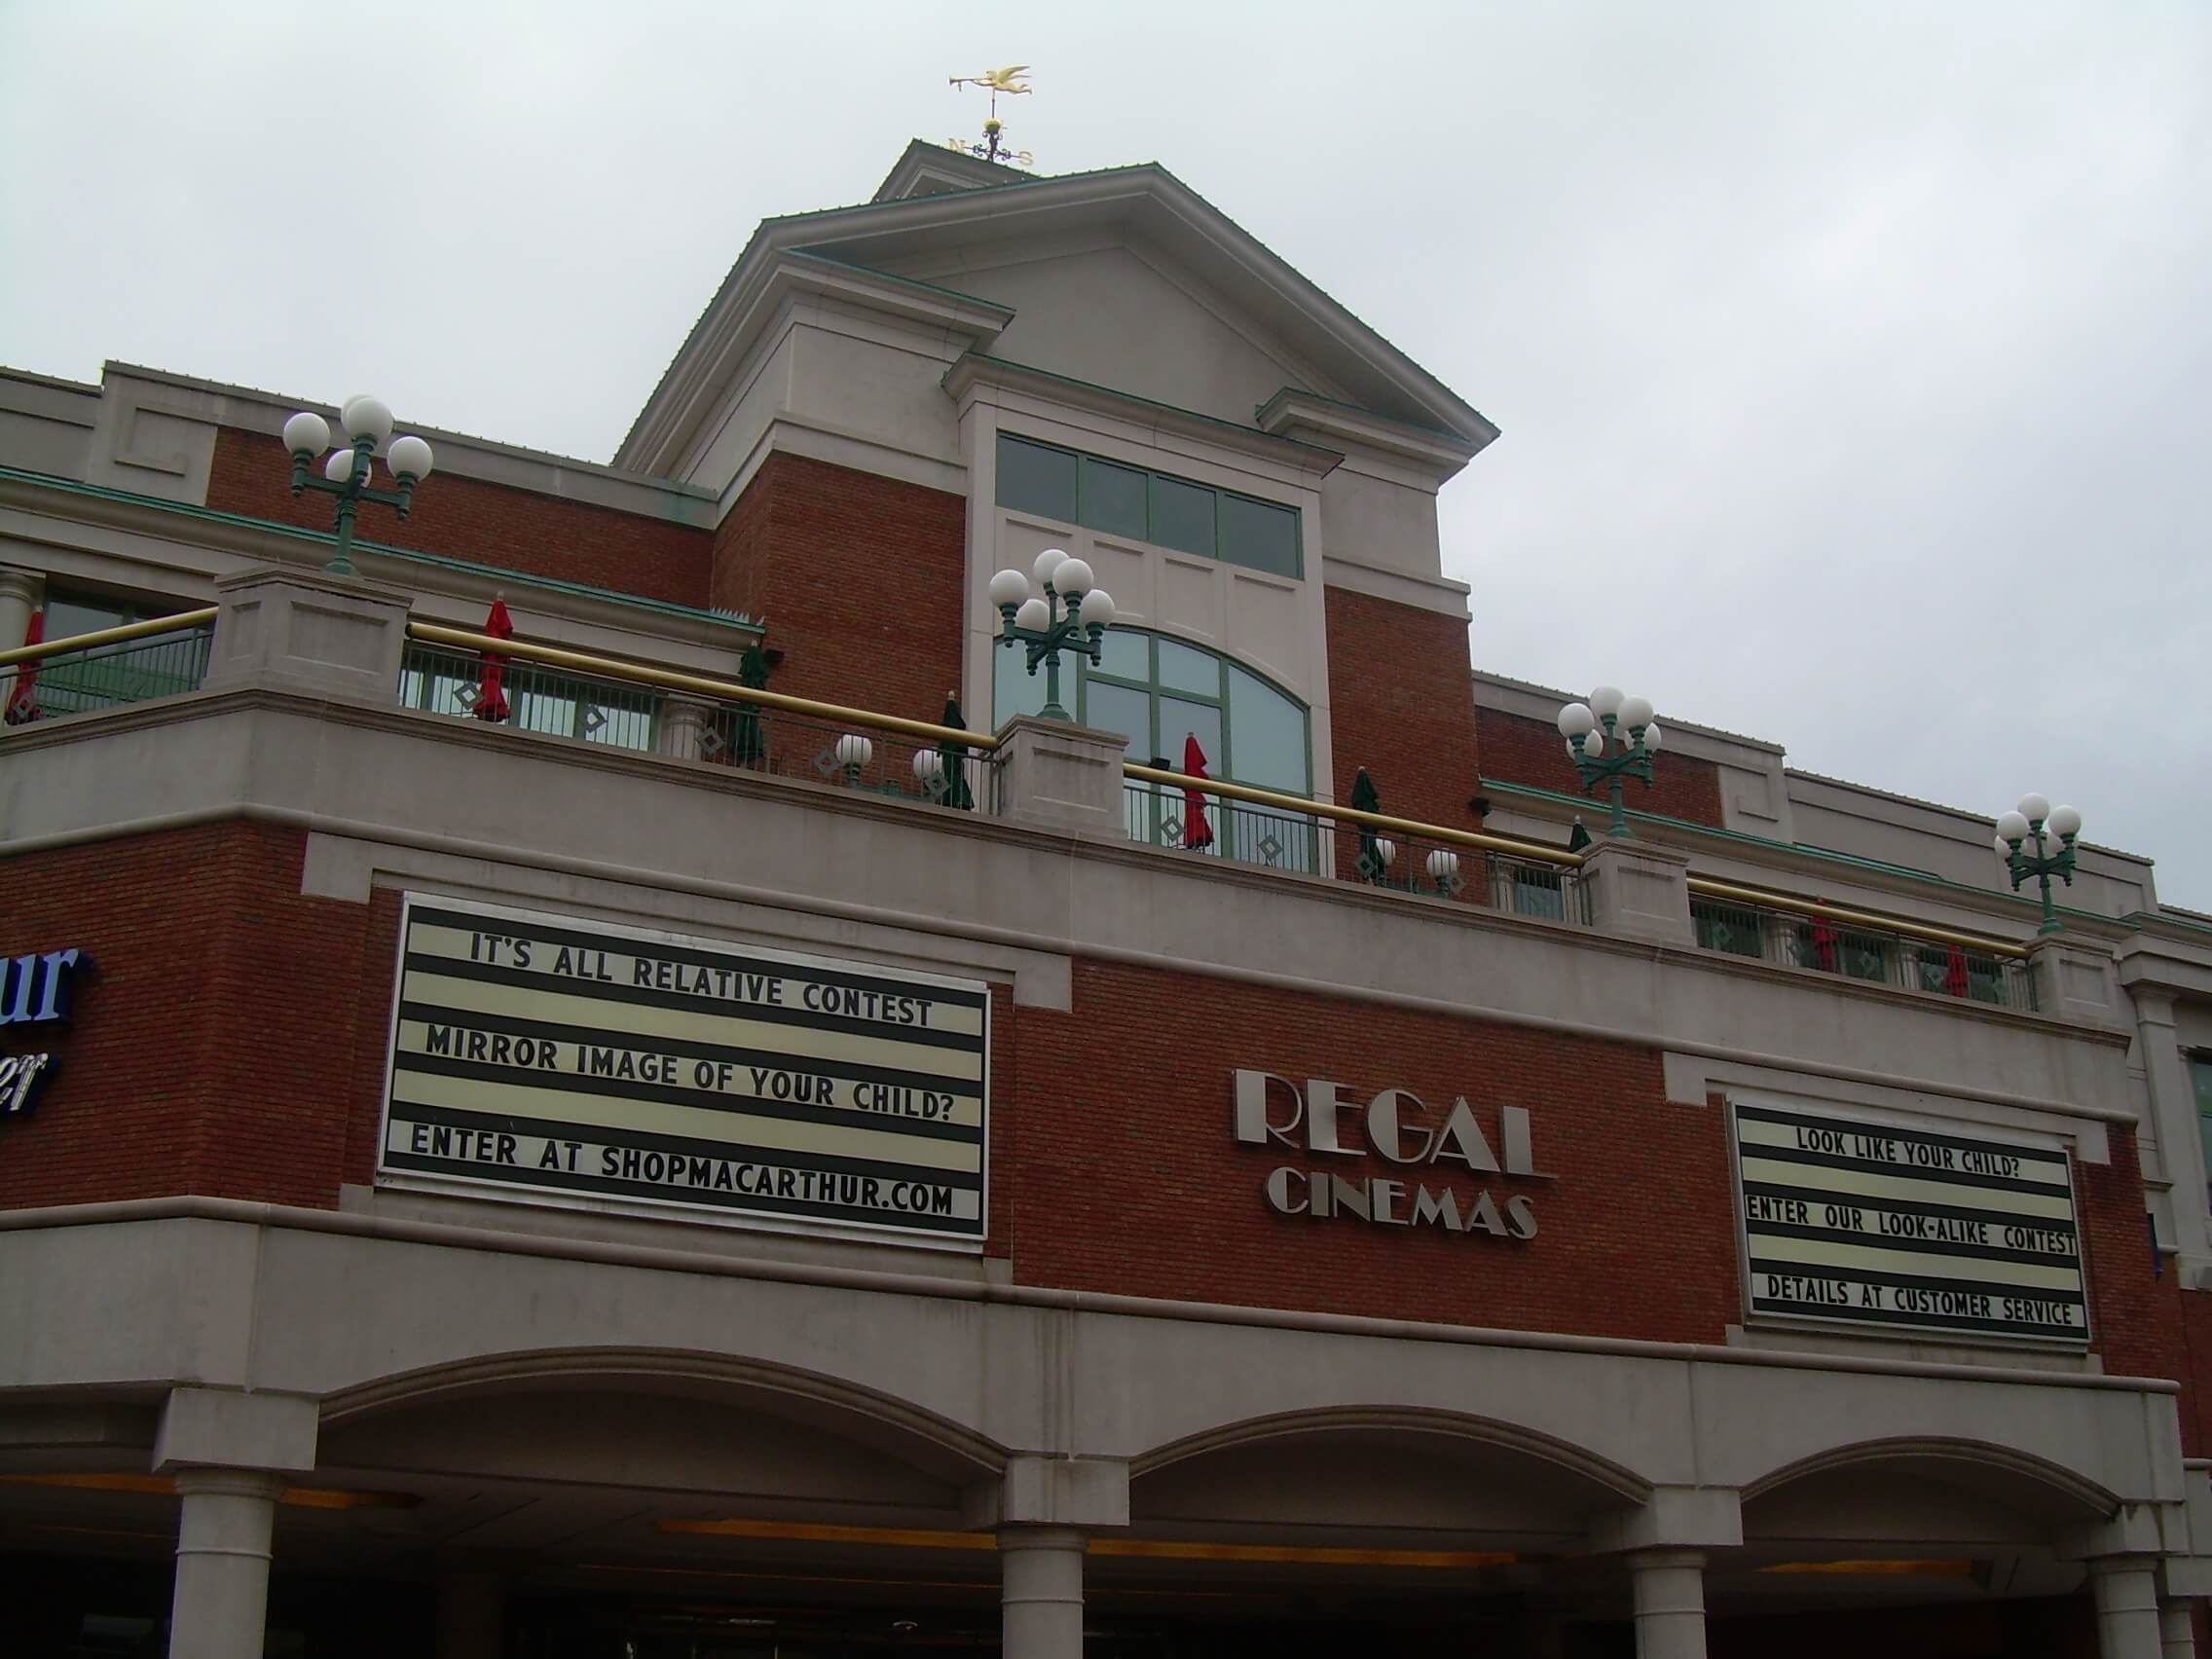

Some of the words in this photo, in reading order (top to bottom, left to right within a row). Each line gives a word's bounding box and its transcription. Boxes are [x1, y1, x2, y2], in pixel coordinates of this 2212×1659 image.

[470, 933, 532, 968] IT'S
[553, 946, 612, 981] ALL
[633, 958, 783, 1005] RELATIVE
[803, 984, 933, 1027] CONTEST
[426, 1023, 557, 1069] MIRROR
[577, 1045, 678, 1085] IMAGE
[694, 1060, 734, 1090] OF
[750, 1067, 834, 1106] YOUR
[854, 1084, 955, 1123] CHILD?
[1232, 1068, 1559, 1179] REGAL
[1797, 1127, 1846, 1155] LOOK
[1855, 1135, 1897, 1161] LIKE
[1903, 1142, 1953, 1169] YOUR
[1962, 1151, 2020, 1178] CHILD?
[411, 1124, 517, 1164] ENTER
[539, 1140, 582, 1171] AT
[602, 1147, 953, 1216] SHOPMACARTHUR.COM
[1266, 1166, 1538, 1239] CINEMAS
[1747, 1195, 1808, 1225] ENTER
[1825, 1205, 1863, 1232] OUR
[1879, 1211, 1988, 1244] LOOK-ALIKE
[2005, 1227, 2076, 1255] CONTEST
[1768, 1274, 1849, 1305] DETAILS
[1862, 1285, 1884, 1309] AT
[1895, 1287, 1991, 1318] CUSTOMER
[2003, 1298, 2072, 1325] SERVICE
